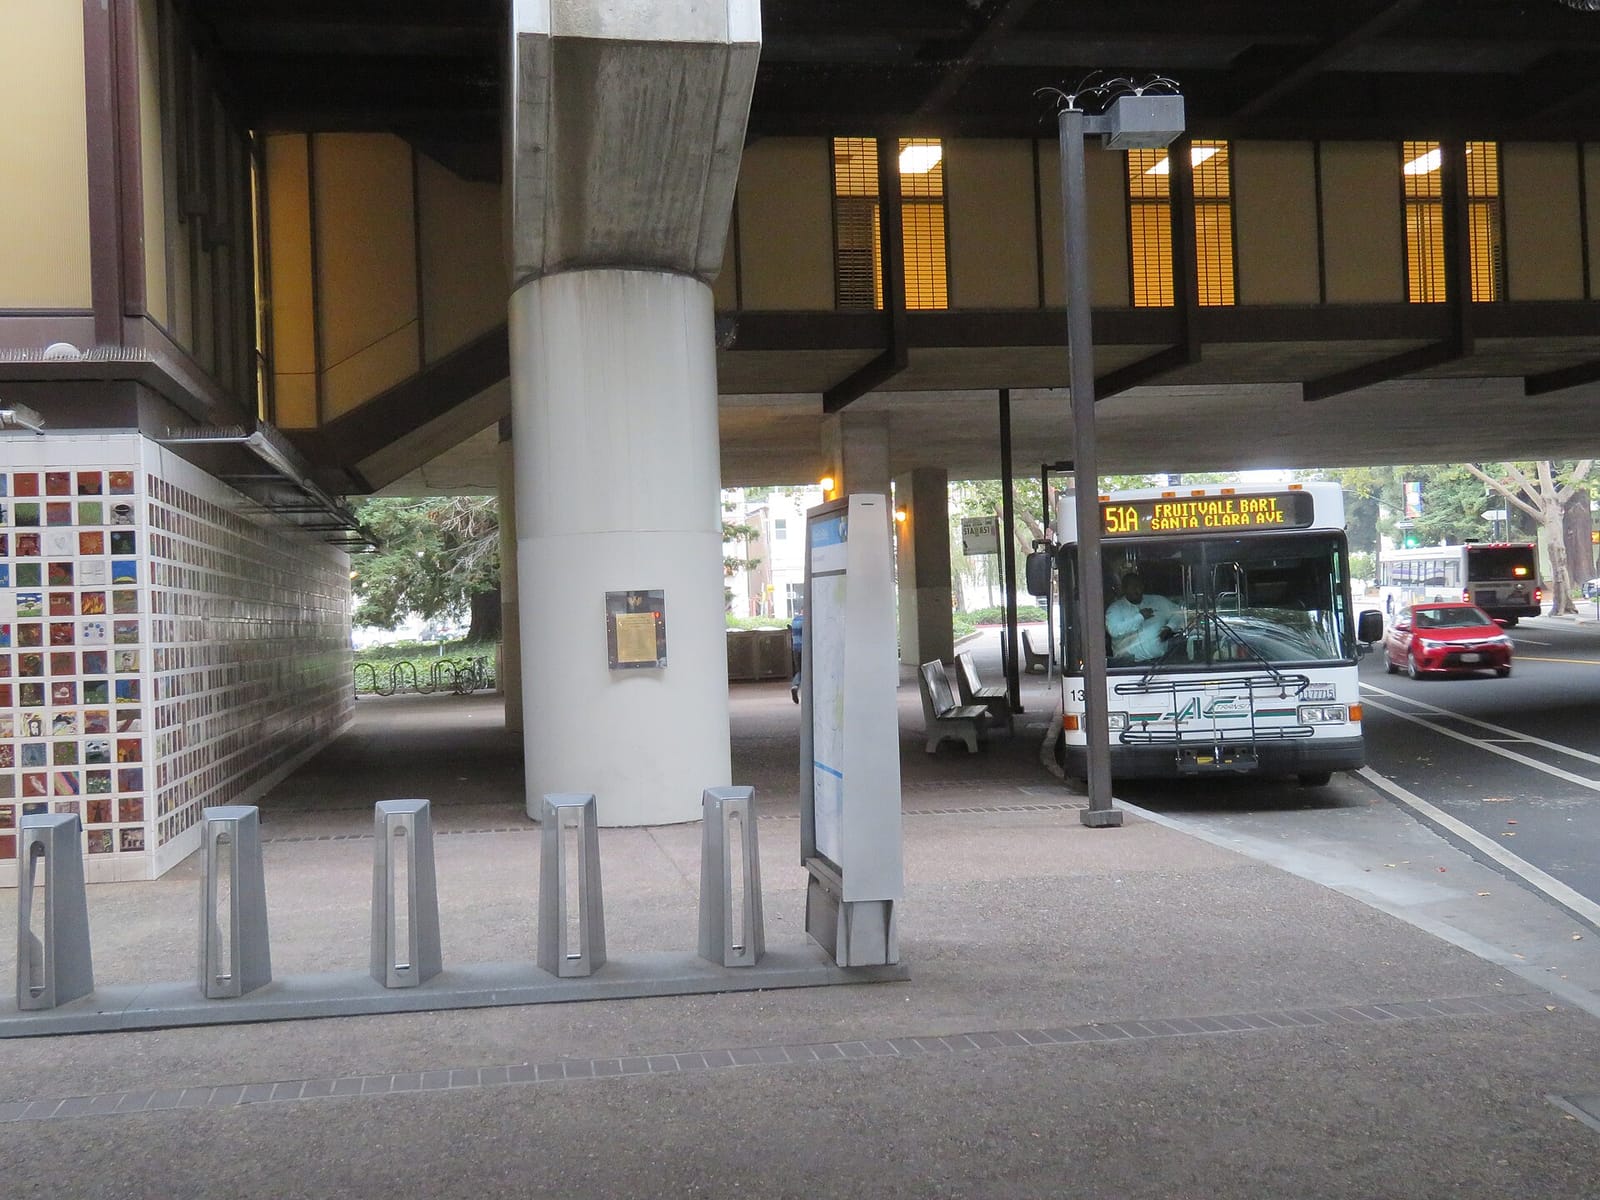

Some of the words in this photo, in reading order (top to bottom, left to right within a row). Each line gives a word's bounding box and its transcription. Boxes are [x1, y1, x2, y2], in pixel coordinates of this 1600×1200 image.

[1155, 500, 1233, 517] FRUITVALE
[1240, 498, 1276, 513] BART
[1105, 506, 1138, 532] 51A
[1151, 516, 1198, 530] SANTA
[1204, 512, 1250, 527] CLARA
[1256, 511, 1284, 524] AVE
[1163, 696, 1249, 720] AC
